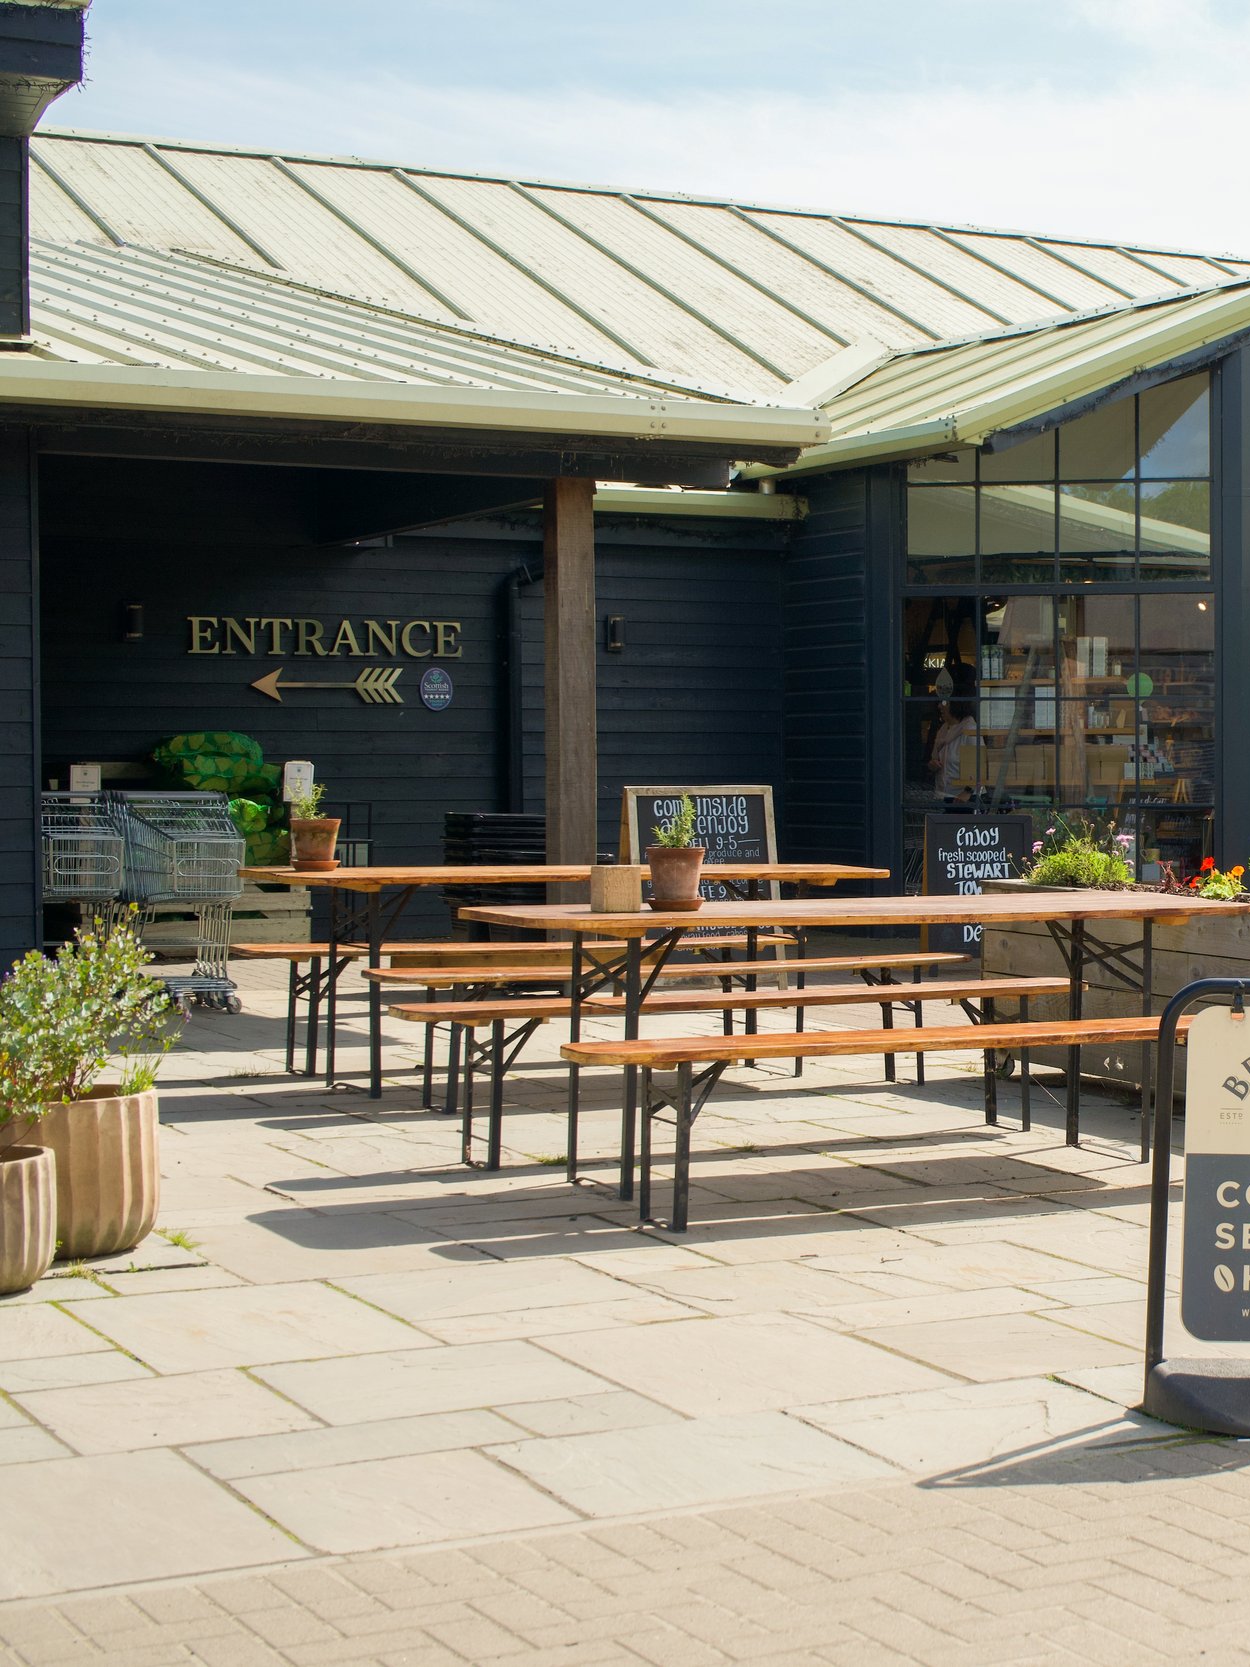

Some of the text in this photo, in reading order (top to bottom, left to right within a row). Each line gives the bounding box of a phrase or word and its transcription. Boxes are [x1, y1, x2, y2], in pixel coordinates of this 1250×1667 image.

[187, 616, 463, 658] ENTRANCE
[424, 681, 449, 689] Scottish
[696, 796, 747, 817] inside
[697, 815, 749, 834] enjoy
[957, 826, 1000, 847] enjoy
[708, 848, 760, 860] produce and
[939, 847, 1006, 863] fresh scooped
